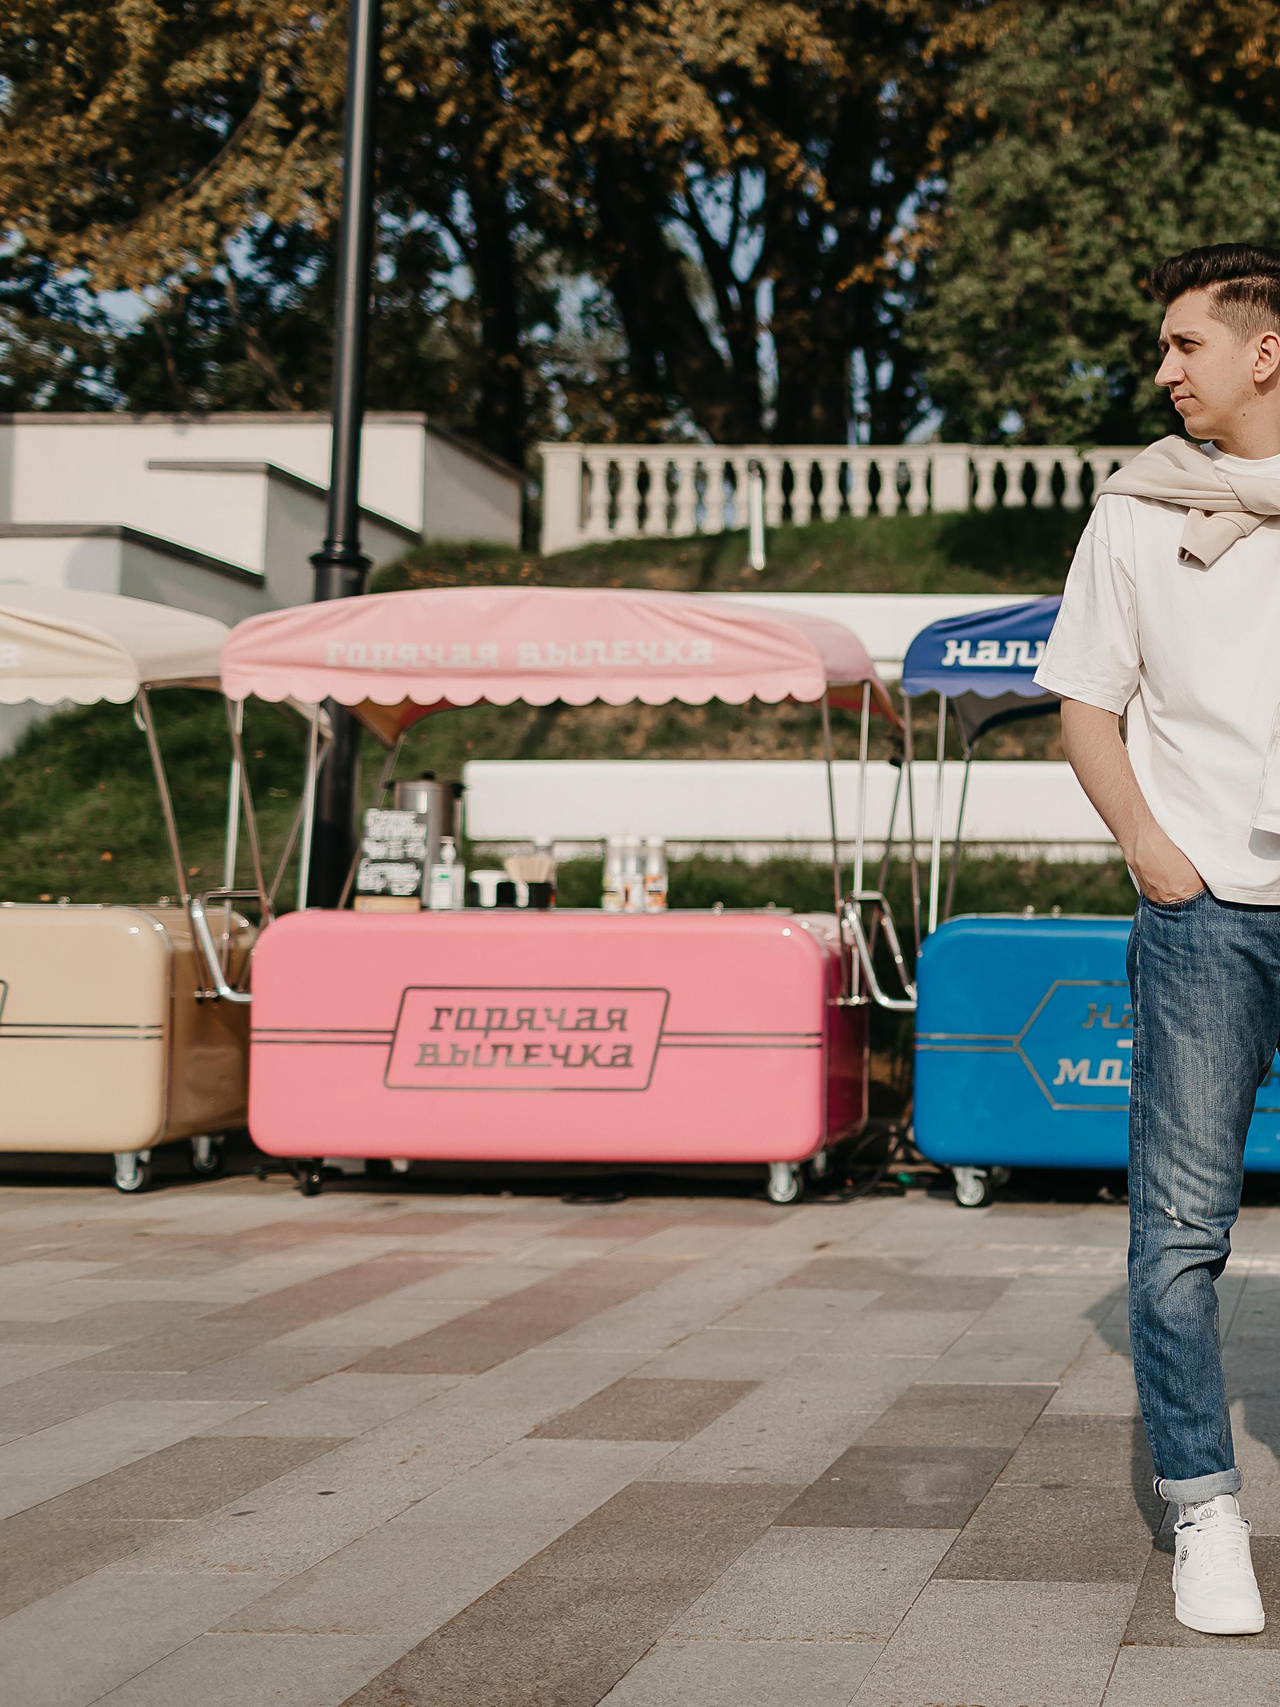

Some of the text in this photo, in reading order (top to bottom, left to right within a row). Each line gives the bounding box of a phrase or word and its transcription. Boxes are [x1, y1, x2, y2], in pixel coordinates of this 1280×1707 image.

[326, 639, 713, 671] горячая выпечка
[430, 1007, 627, 1038] горячая
[415, 1043, 633, 1067] выпечка
